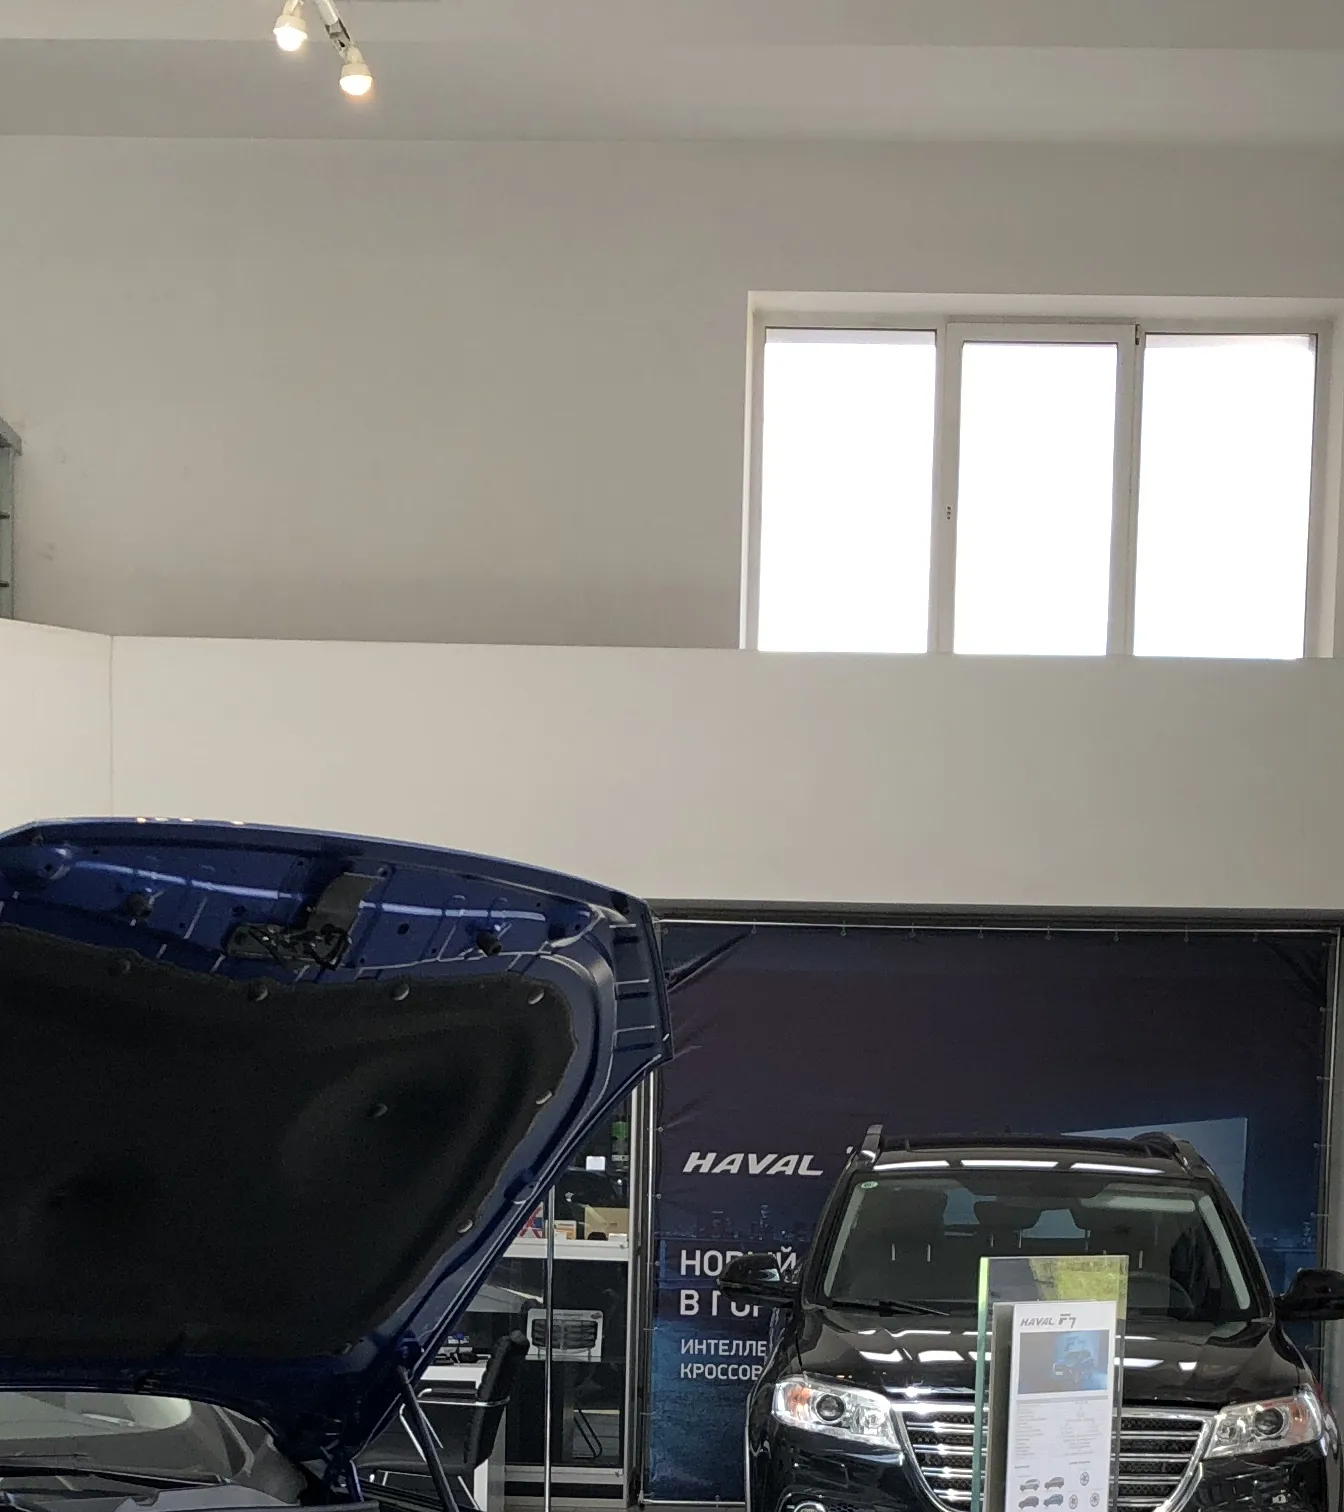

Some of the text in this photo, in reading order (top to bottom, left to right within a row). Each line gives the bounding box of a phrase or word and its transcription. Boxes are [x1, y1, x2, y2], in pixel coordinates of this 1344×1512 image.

[683, 1152, 823, 1176] HAVAL
[680, 1289, 700, 1316] В
[1020, 1313, 1077, 1329] HAVAL F7
